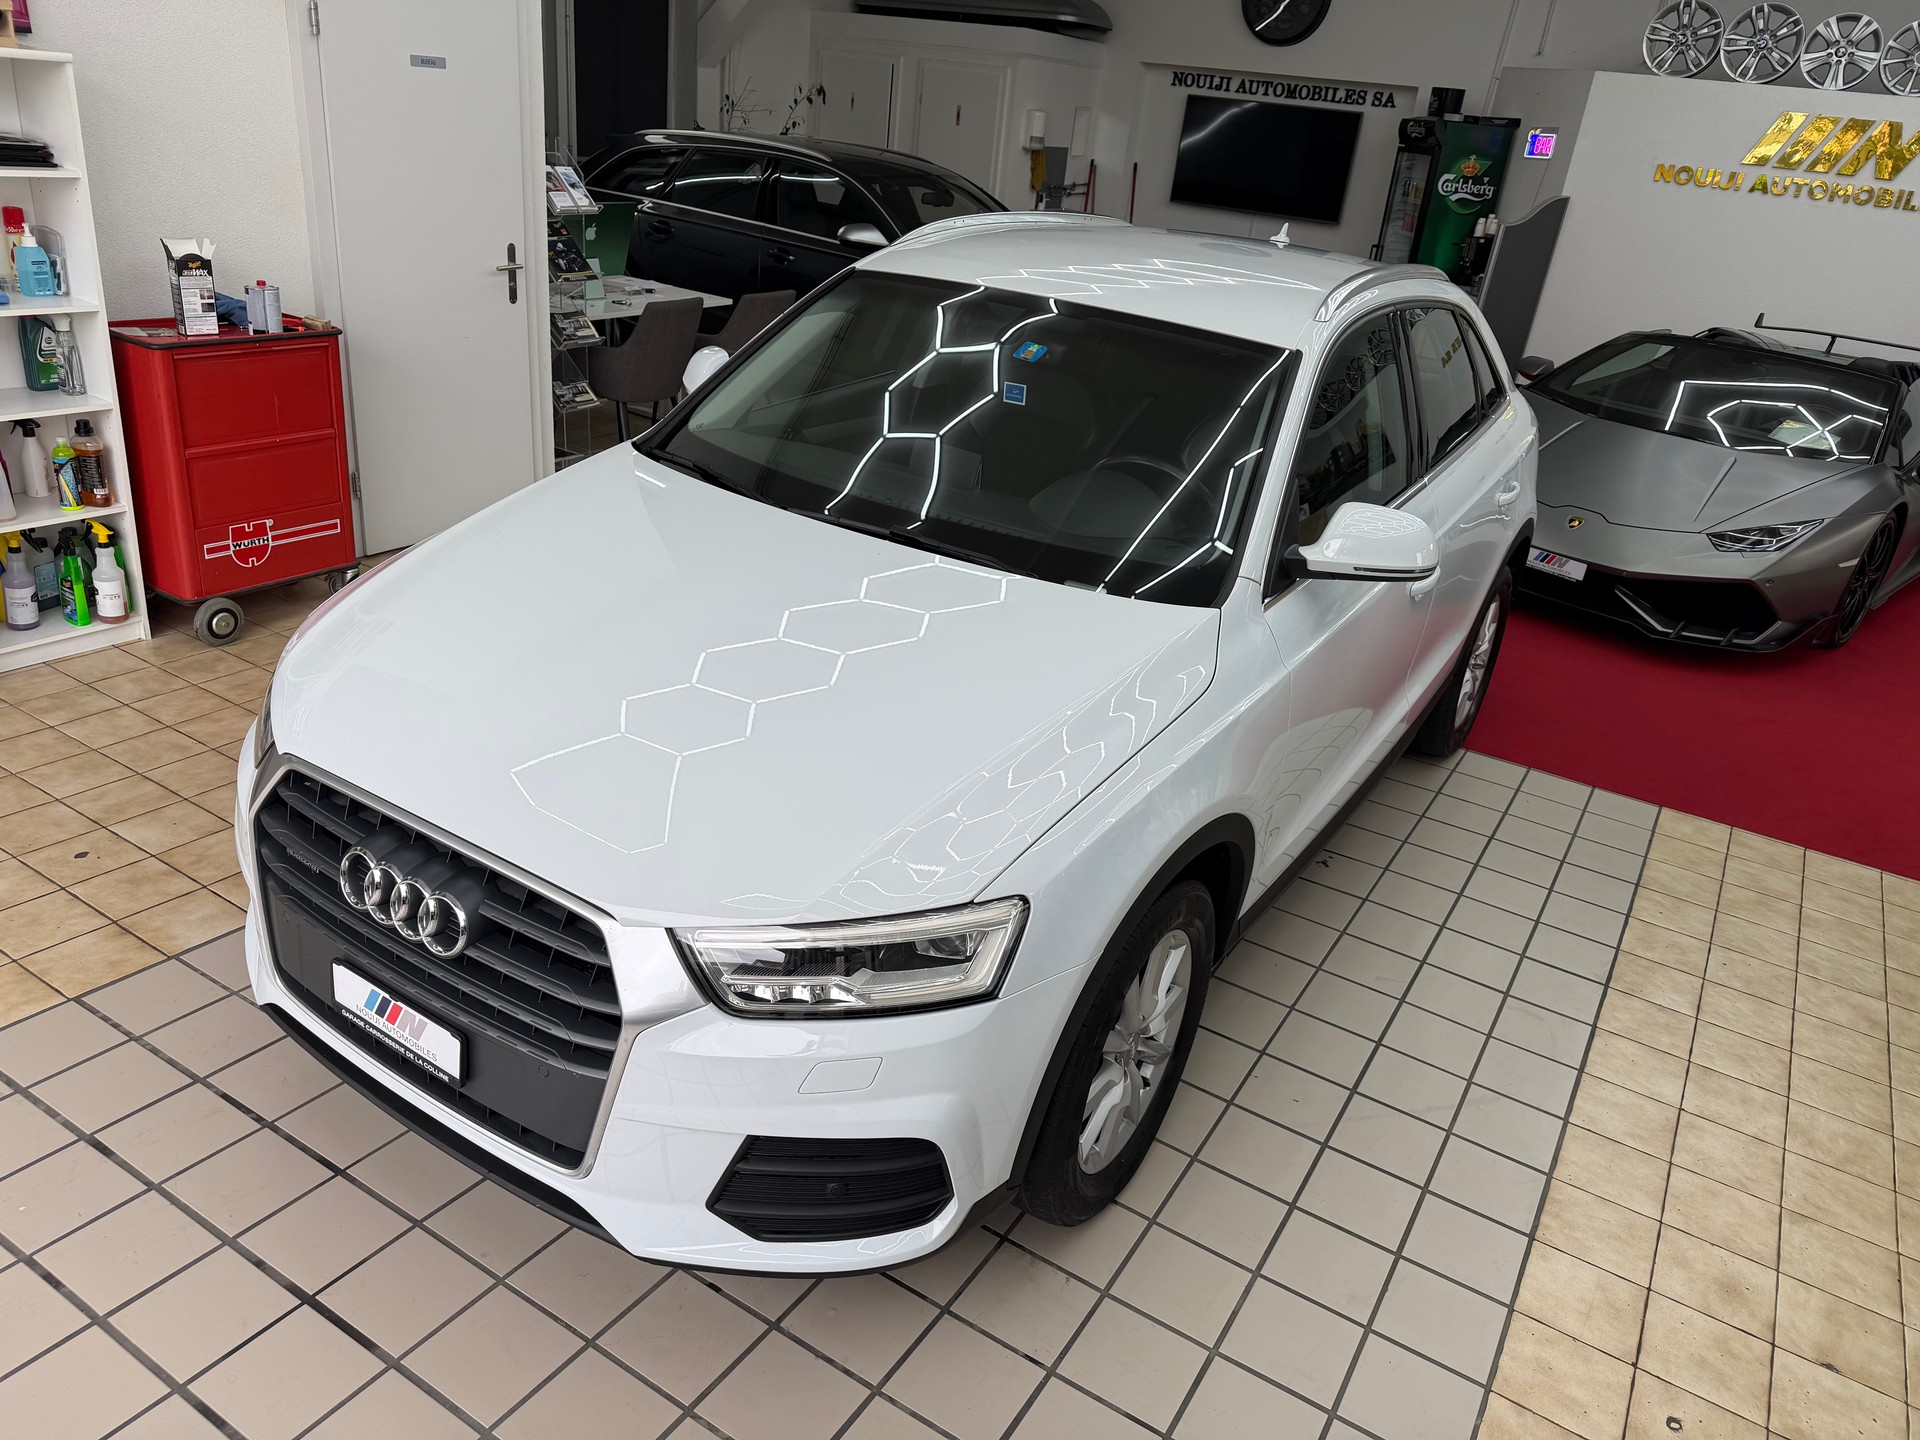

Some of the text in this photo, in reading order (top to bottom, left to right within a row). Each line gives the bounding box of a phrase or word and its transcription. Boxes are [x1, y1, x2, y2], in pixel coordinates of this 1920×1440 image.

[1171, 71, 1396, 108] NOUIJI AUTOMOBILES SA
[1533, 137, 1553, 155] BAR
[1437, 173, 1496, 200] Carlsberg
[1654, 163, 1920, 212] NOUIJI AUTOMOBIL
[341, 1009, 450, 1082] GARAGE CARROSSERIE DE LA COLLINE
[355, 1004, 438, 1062] NOUIJI AUTOMOBILES
